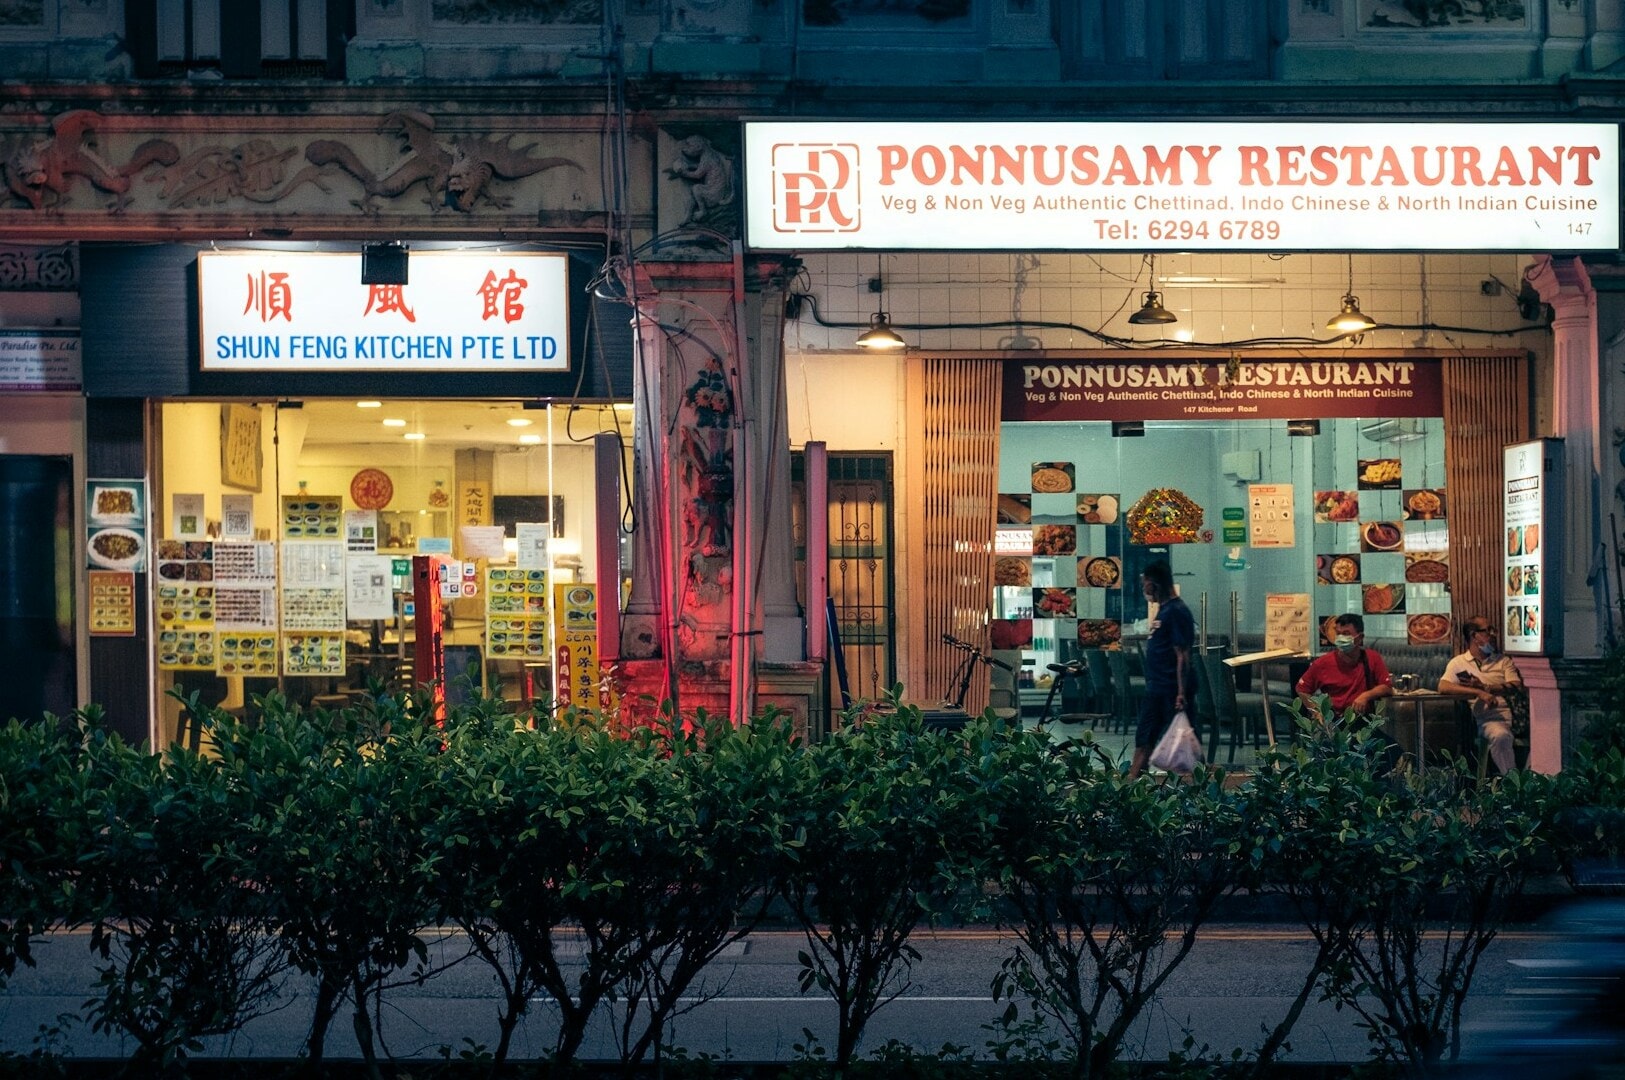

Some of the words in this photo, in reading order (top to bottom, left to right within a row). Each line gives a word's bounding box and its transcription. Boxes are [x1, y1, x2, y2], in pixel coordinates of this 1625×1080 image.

[877, 145, 1222, 187] PONNUSAMY
[1238, 145, 1601, 187] RESTAURANT
[882, 195, 916, 213] Veg
[925, 195, 937, 210] &
[945, 195, 983, 210] Non
[991, 195, 1025, 213] Veg
[1033, 195, 1126, 210] Authentic
[1242, 195, 1284, 210] Indo
[1292, 195, 1370, 210] Chinese
[1378, 195, 1390, 210] &
[1398, 195, 1450, 210] North
[1459, 195, 1518, 210] Indian
[1525, 195, 1598, 210] Cuisine
[1094, 219, 1138, 240] Tel:
[1147, 220, 1210, 240] 6294
[1219, 220, 1281, 240] 6789
[1567, 222, 1592, 235] 147
[216, 335, 281, 359] SHUN
[289, 335, 347, 359] FENG
[355, 335, 452, 360] KITCHEN
[462, 336, 504, 360] PTE
[513, 336, 557, 360] LTD
[1023, 364, 1208, 389] PONNUSAMY
[1025, 392, 1046, 403] Veg
[1048, 392, 1057, 401] &
[1059, 392, 1082, 401] Non
[1083, 391, 1105, 403] Veg
[1107, 390, 1159, 401] Authentic
[1161, 389, 1217, 401] Chettinad,
[1219, 389, 1244, 399] Indo
[1246, 389, 1291, 399] Chinese
[1292, 389, 1301, 398] &
[1303, 388, 1334, 398] North
[1336, 388, 1370, 398] Indian
[1372, 388, 1414, 398] Cuisine
[1238, 405, 1258, 413] Road
